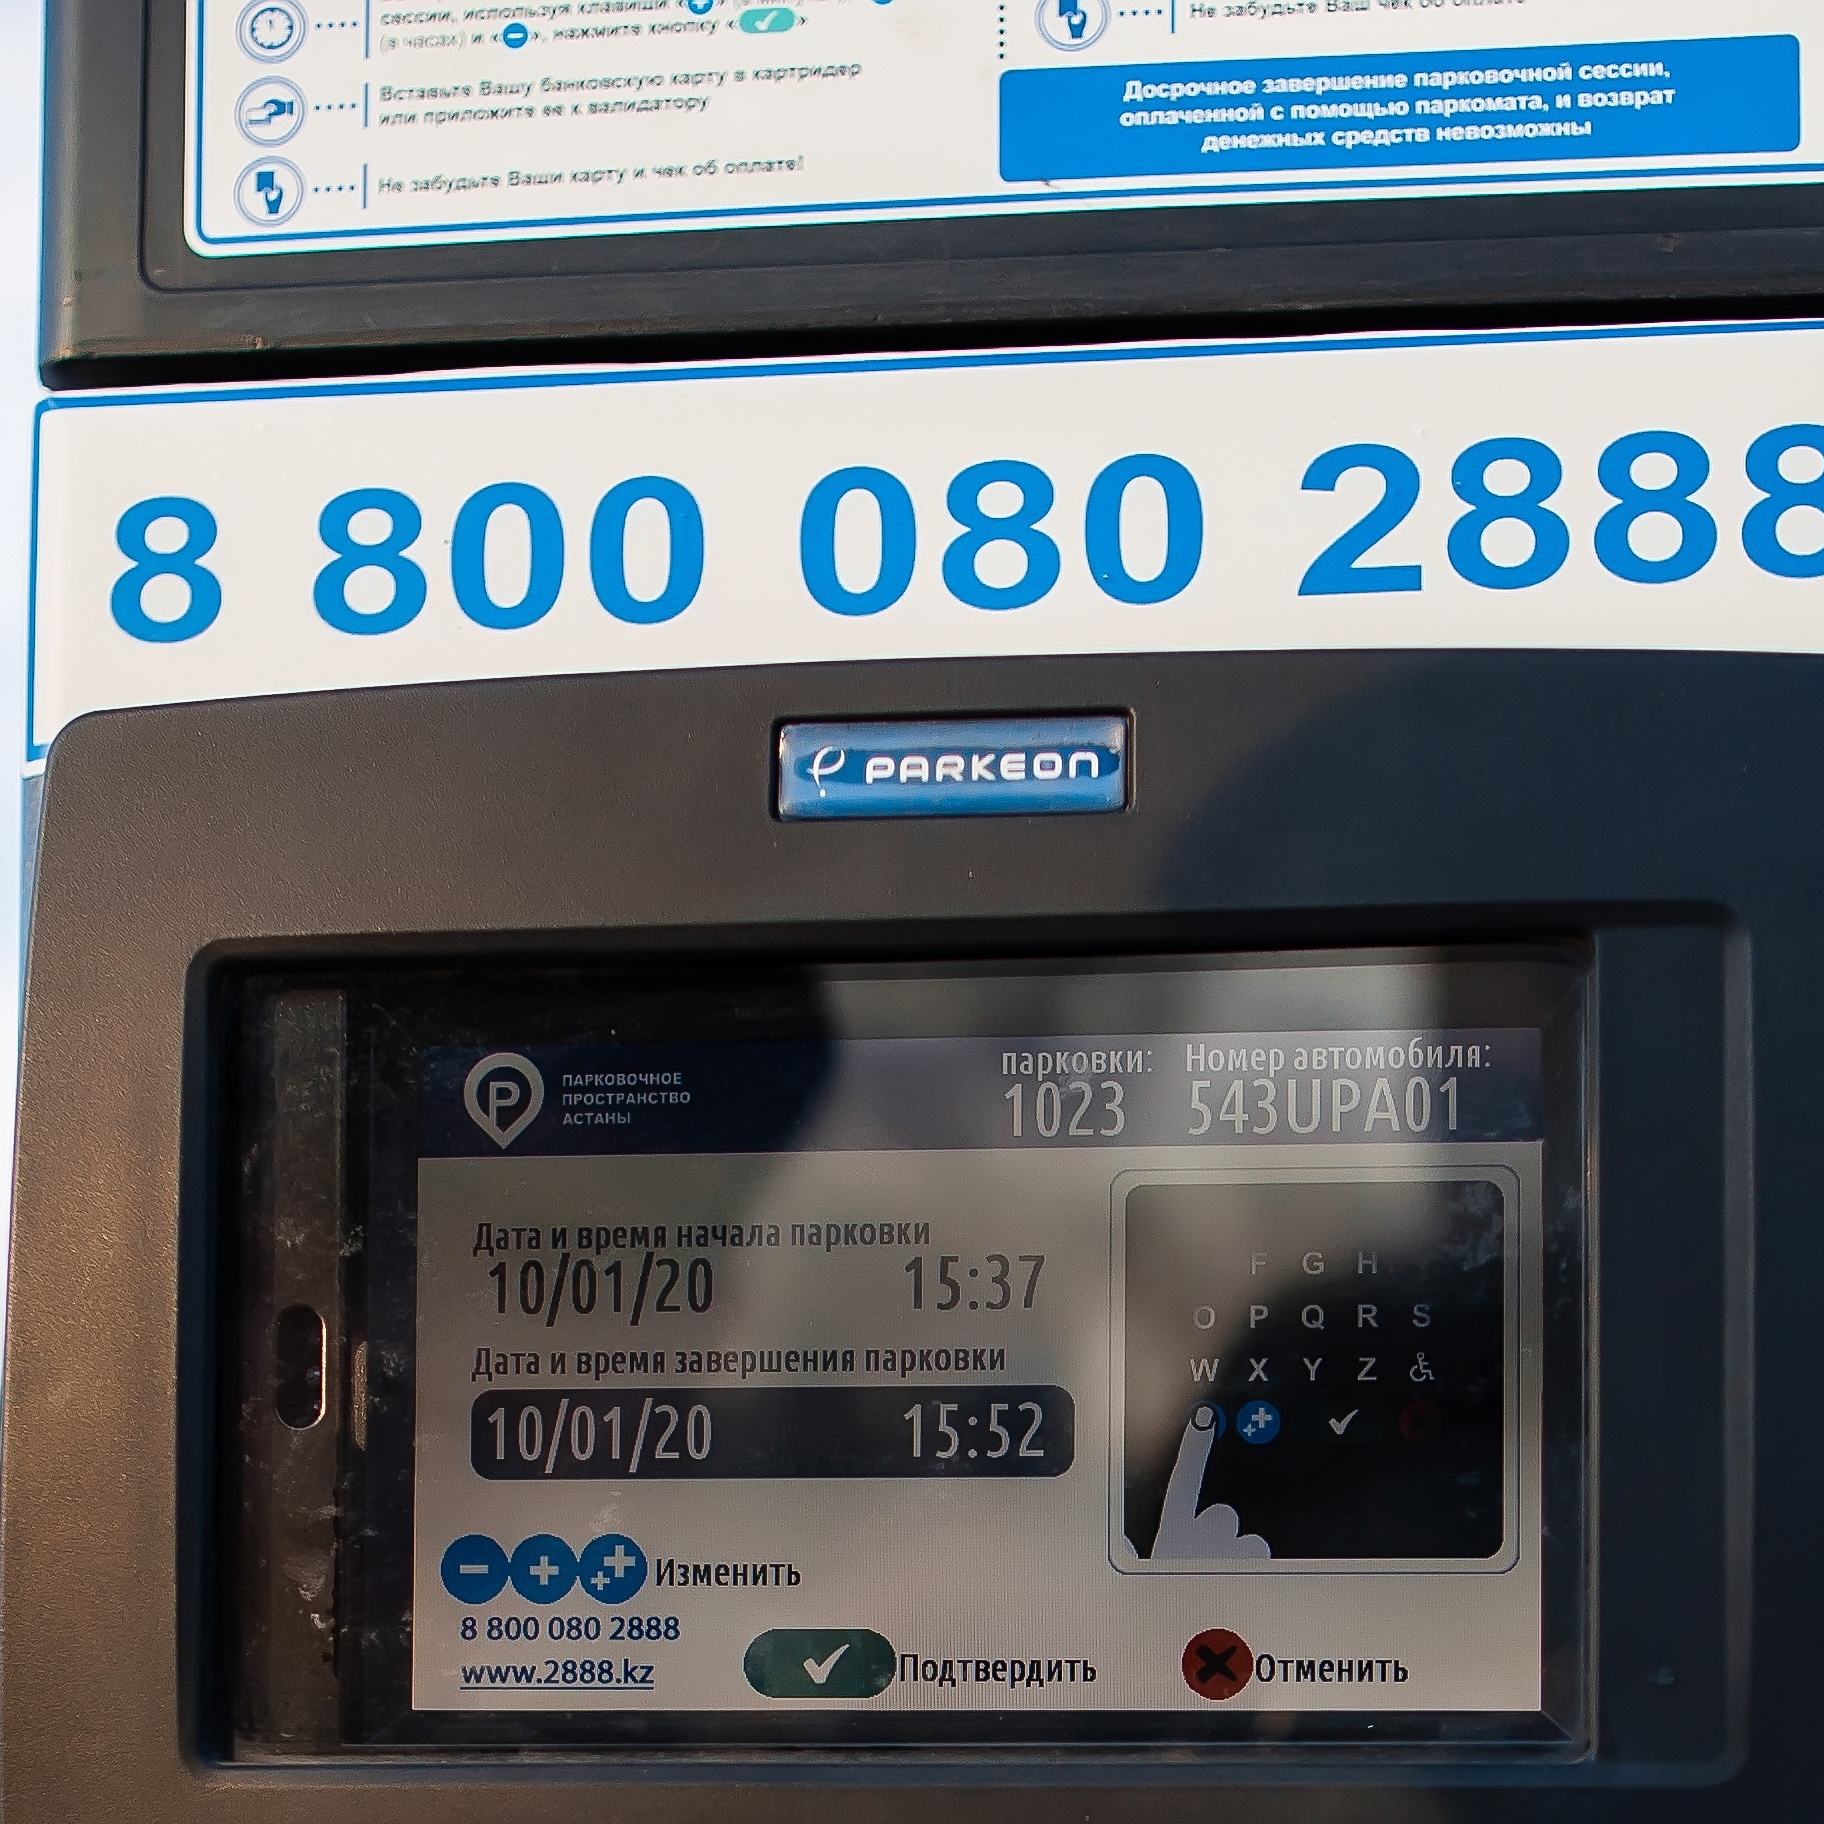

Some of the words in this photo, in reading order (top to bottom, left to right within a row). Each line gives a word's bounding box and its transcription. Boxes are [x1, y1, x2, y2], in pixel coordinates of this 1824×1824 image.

[1189, 3, 1217, 19] Не
[379, 83, 472, 101] Вставьте
[479, 79, 533, 97] Вашу
[539, 74, 665, 92] банковскую
[670, 70, 728, 89] карту
[752, 62, 862, 84] картридер
[1123, 79, 1257, 103] Досрочное
[1261, 72, 1408, 96] завершение
[1413, 62, 1573, 90] парковочной
[1578, 61, 1671, 80] сессии,
[379, 112, 417, 127] или
[423, 103, 536, 126] приложите
[588, 96, 710, 114] валидатору
[1119, 102, 1265, 127] оплаченной
[1270, 105, 1285, 121] с
[1290, 101, 1409, 120] помощью
[1414, 93, 1550, 118] паркомата,
[1555, 93, 1572, 109] и
[1577, 88, 1676, 111] возврат
[1201, 131, 1326, 154] денежных
[1331, 127, 1430, 149] средств
[1436, 120, 1592, 142] невозможны
[378, 175, 405, 194] Не
[410, 172, 501, 194] забудьте
[507, 169, 565, 187] Ваши
[570, 167, 627, 187] карту
[653, 164, 687, 178] чек
[693, 158, 718, 176] об
[724, 153, 804, 175] оплате!
[110, 496, 222, 643] 8
[313, 476, 704, 635] 800
[800, 454, 1203, 616] 080
[865, 751, 1100, 784] PARKEON
[1000, 1046, 1153, 1079] парковки:
[1185, 1043, 1285, 1075] Номер
[1293, 1039, 1491, 1073] автомобиля:
[563, 1073, 682, 1087] ПАРКОВОЧНОЕ
[562, 1092, 691, 1106] ПРОСТРАНСТВО
[1003, 1079, 1127, 1138] 1023
[1187, 1075, 1460, 1136] 543UPA01
[562, 1113, 631, 1125] АСТАНЫ
[473, 1222, 543, 1257] Дата
[550, 1227, 568, 1250] и
[576, 1225, 668, 1256] время
[676, 1223, 781, 1249] начала
[789, 1218, 931, 1252] парковки
[1249, 1251, 1269, 1274] F
[1301, 1251, 1325, 1275] G
[1357, 1251, 1378, 1274] H
[487, 1252, 714, 1327] 10/01/20
[903, 1253, 1045, 1313] 15:37
[1193, 1305, 1216, 1329] O
[1250, 1305, 1269, 1328] P
[1301, 1304, 1325, 1330] Q
[1357, 1304, 1379, 1328] R
[1412, 1304, 1431, 1328] S
[471, 1347, 541, 1383] Дата
[549, 1352, 567, 1375] и
[575, 1350, 666, 1381] время
[674, 1348, 856, 1380] завершения
[864, 1344, 1006, 1378] парковки
[1190, 1358, 1220, 1382] W
[1248, 1358, 1269, 1382] X
[1302, 1357, 1323, 1382] Y
[1357, 1357, 1378, 1382] Z
[486, 1397, 712, 1474] 10/01/20
[903, 1402, 1045, 1459] 15:52
[655, 1556, 802, 1591] Изменить
[459, 1617, 477, 1641] 8
[486, 1617, 540, 1642] 800
[547, 1617, 600, 1641] 080
[609, 1616, 680, 1641] 2888
[460, 1659, 654, 1686] www.2888.kz
[899, 1652, 1096, 1690] Подтвердить
[1254, 1653, 1409, 1685] Отменить
